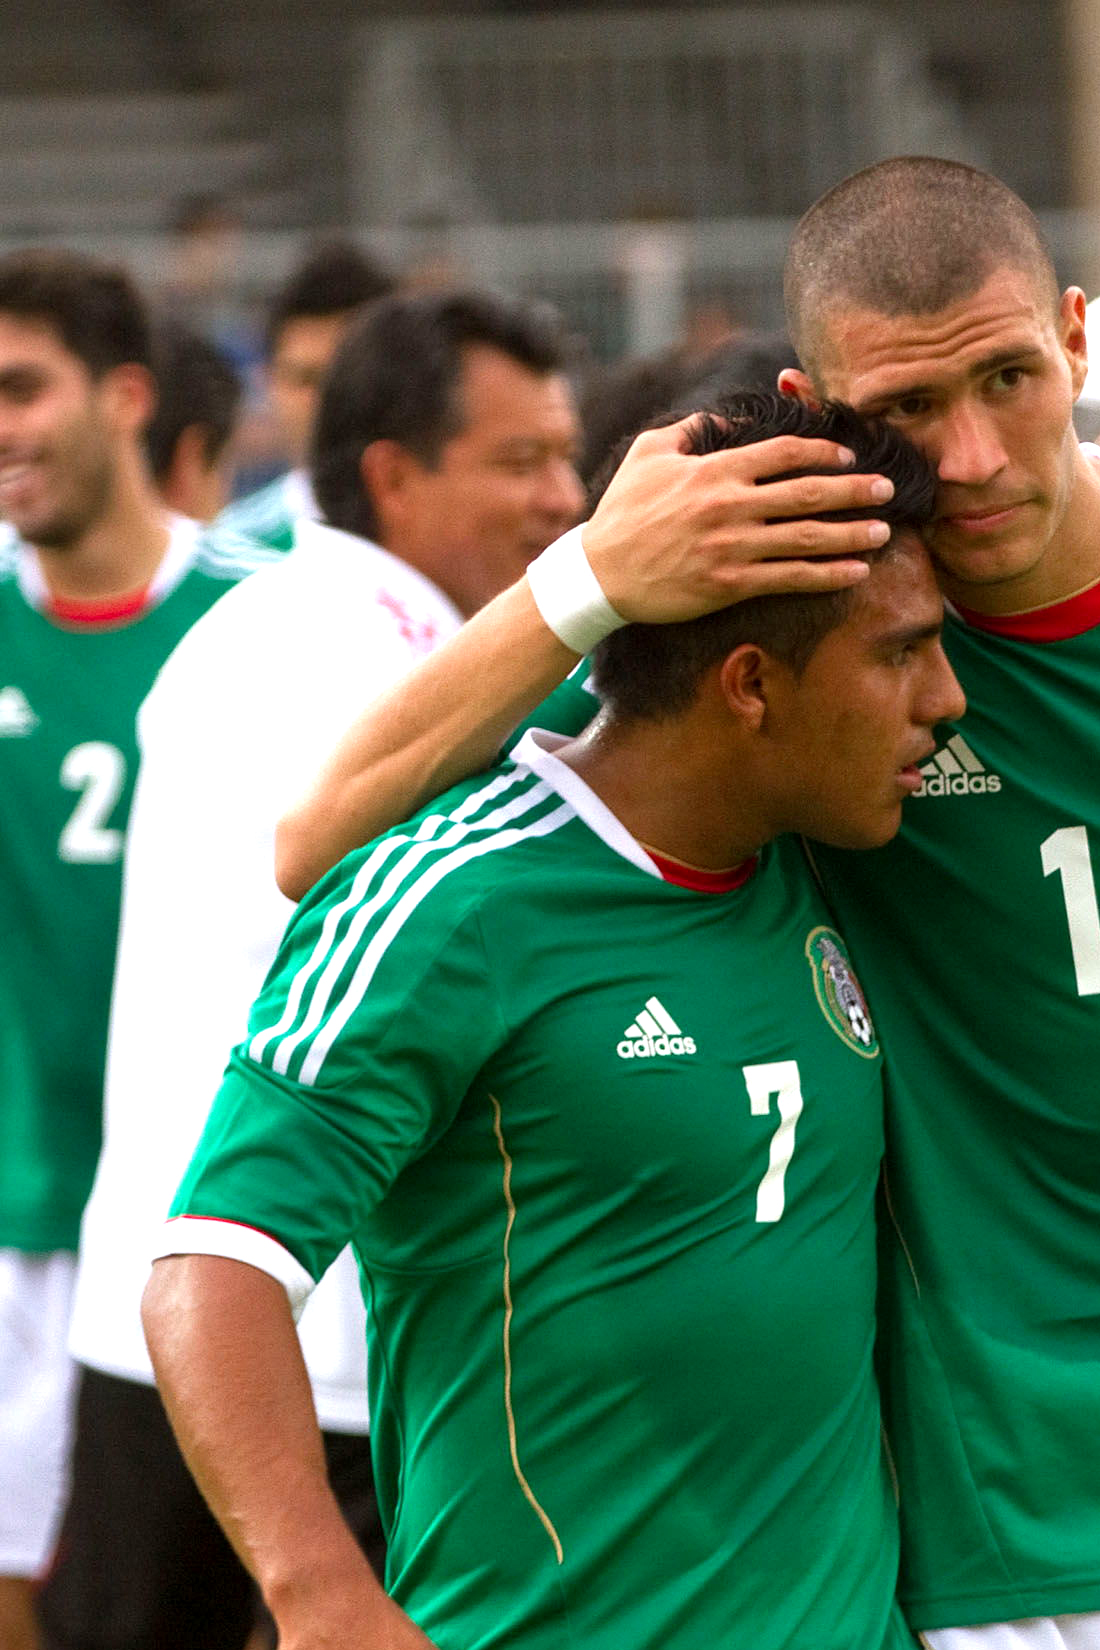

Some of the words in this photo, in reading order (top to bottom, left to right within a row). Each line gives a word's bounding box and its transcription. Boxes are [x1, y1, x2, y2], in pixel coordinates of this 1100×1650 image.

[911, 772, 1002, 797] adidas
[617, 1034, 697, 1058] adidas
[743, 1060, 803, 1223] 7
